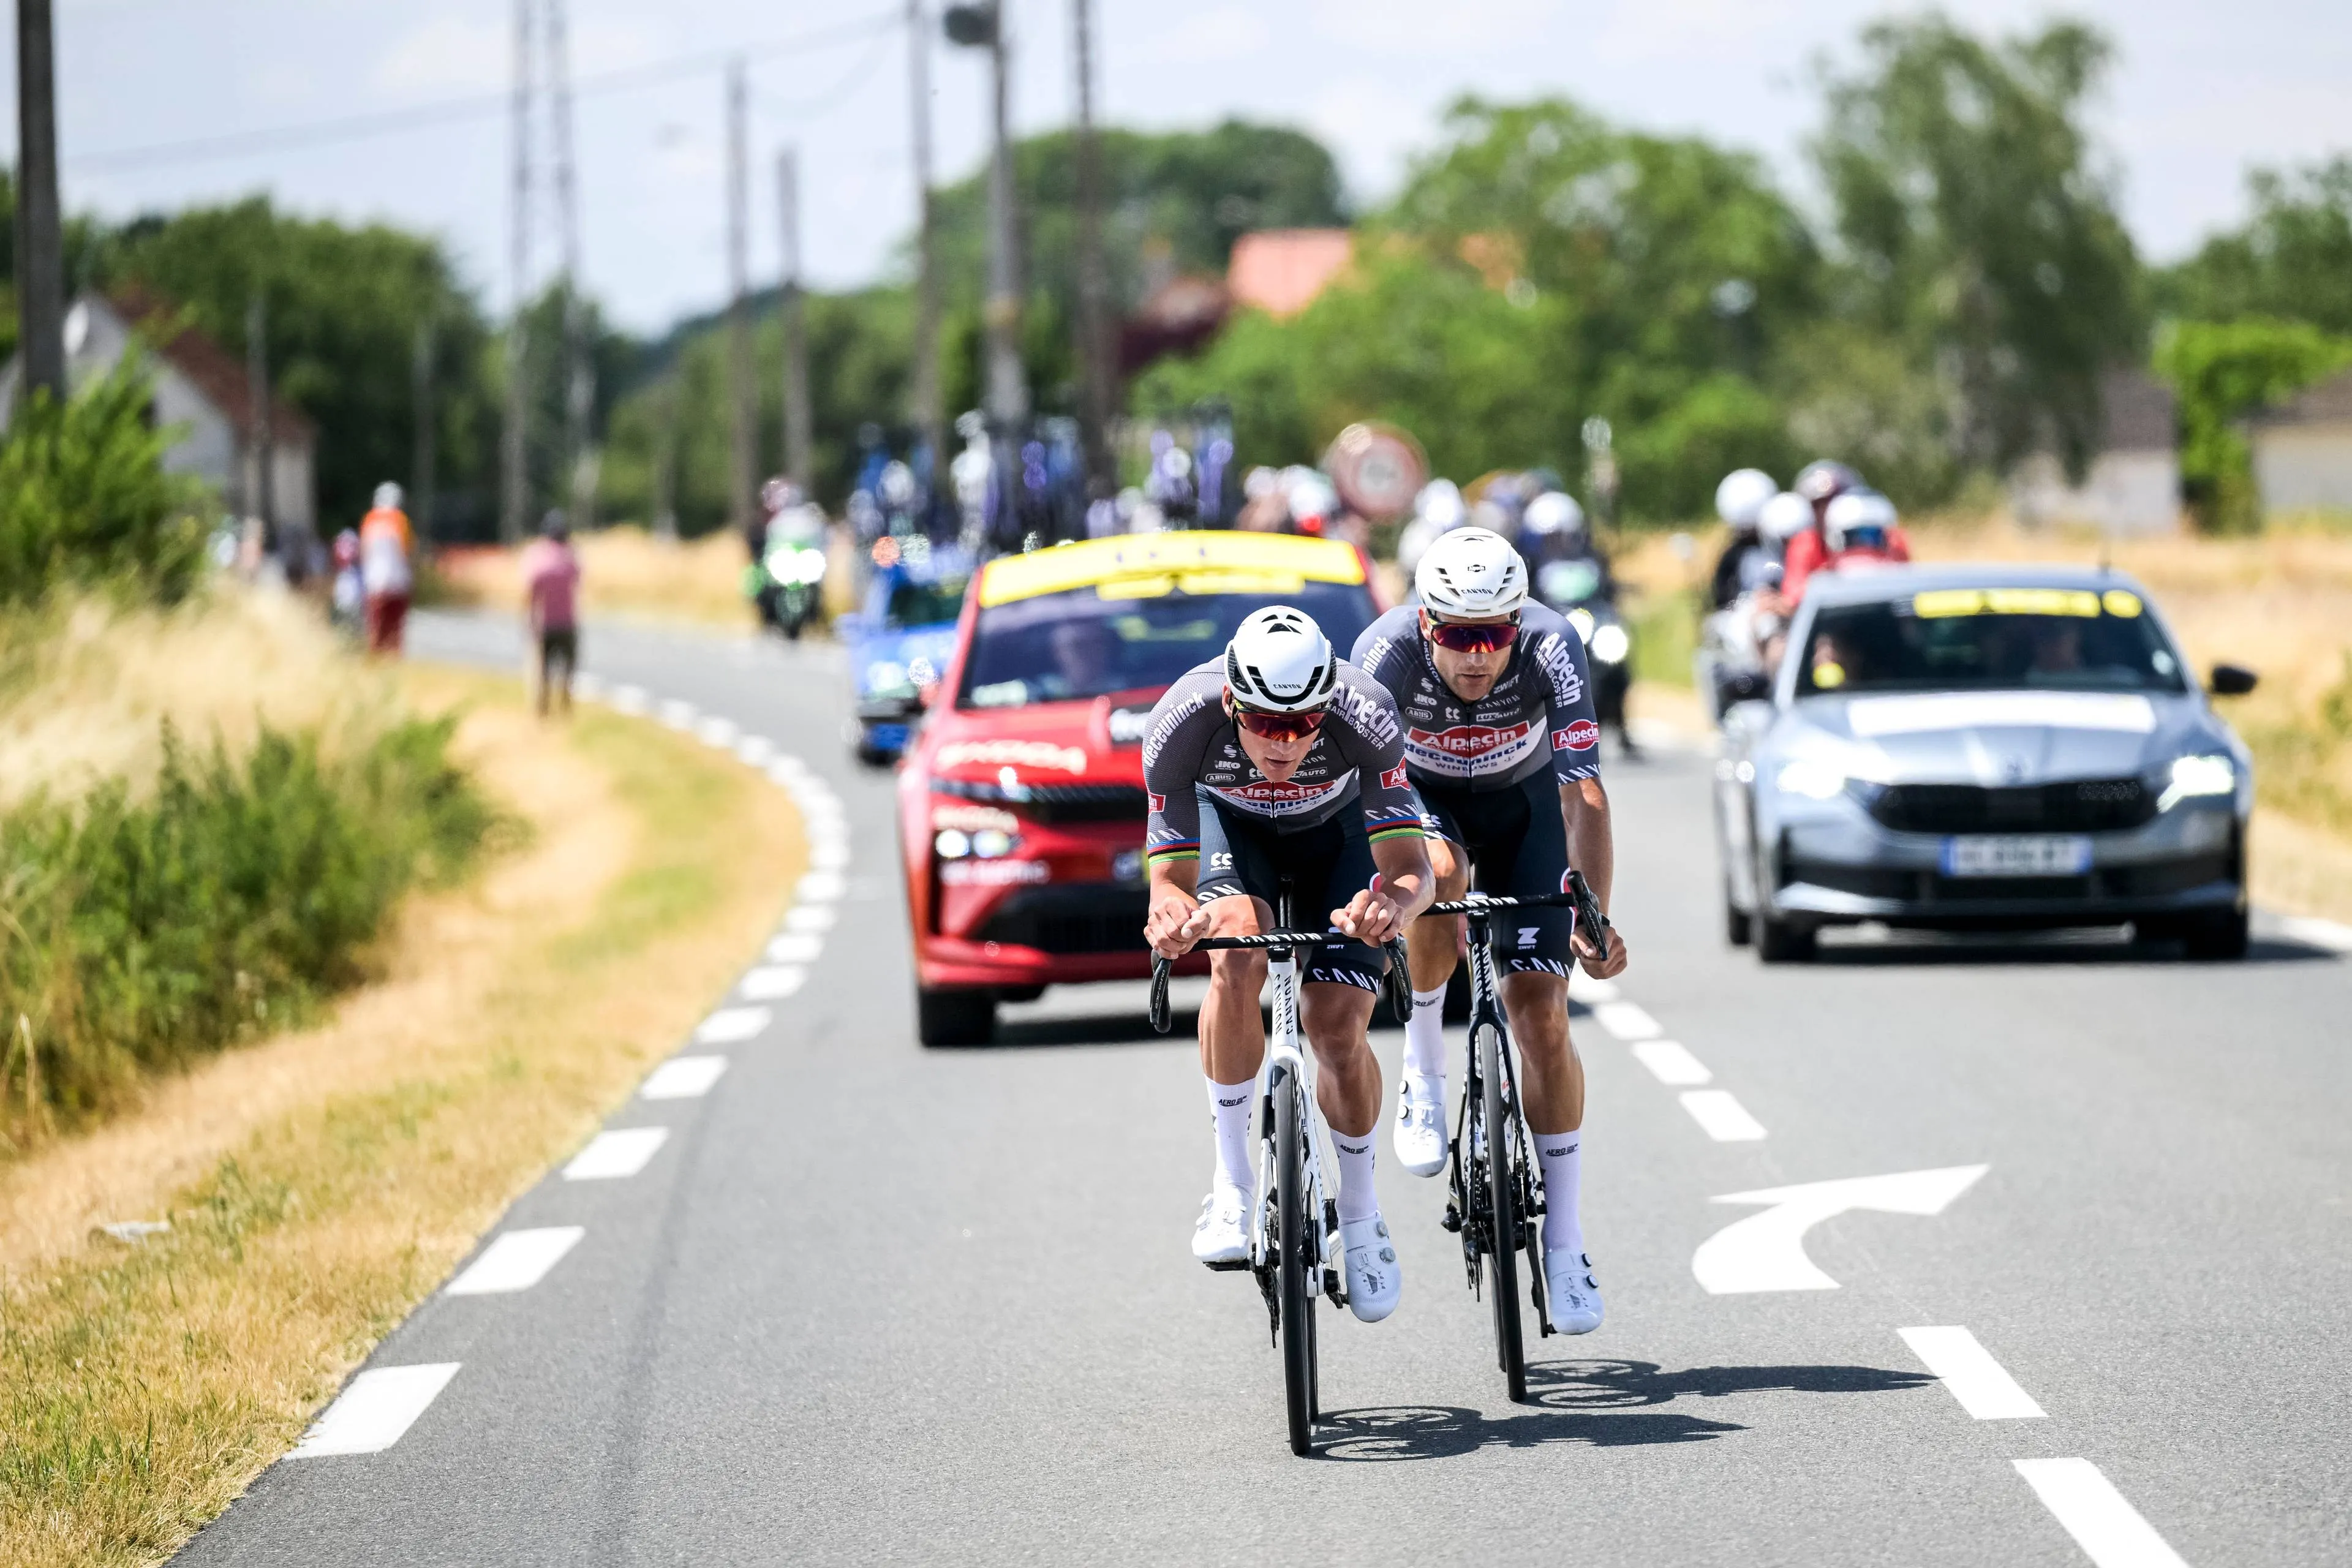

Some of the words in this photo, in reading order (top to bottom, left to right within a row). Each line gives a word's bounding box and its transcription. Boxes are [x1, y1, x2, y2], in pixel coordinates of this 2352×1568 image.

[1362, 636, 1393, 675] ninck
[1539, 632, 1584, 706] Alpecin
[1493, 674, 1520, 694] ZWIFT
[1477, 695, 1520, 709] CANYON
[1330, 680, 1399, 744] Alpecin
[1409, 709, 1429, 718] ABUS
[1144, 692, 1205, 767] deceuninck
[1348, 717, 1385, 750] BOOSTER
[1559, 725, 1599, 744] Alpecin
[1309, 737, 1325, 751] IFT
[1421, 731, 1517, 750] Alpecin
[1404, 739, 1527, 766] deceuninck
[1218, 761, 1241, 769] IKO
[1226, 787, 1323, 798] Alpecin
[1436, 897, 1519, 910] CANYON
[1235, 933, 1322, 943] CANYON
[1313, 968, 1381, 995] CANY
[1284, 974, 1294, 1035] CANYON
